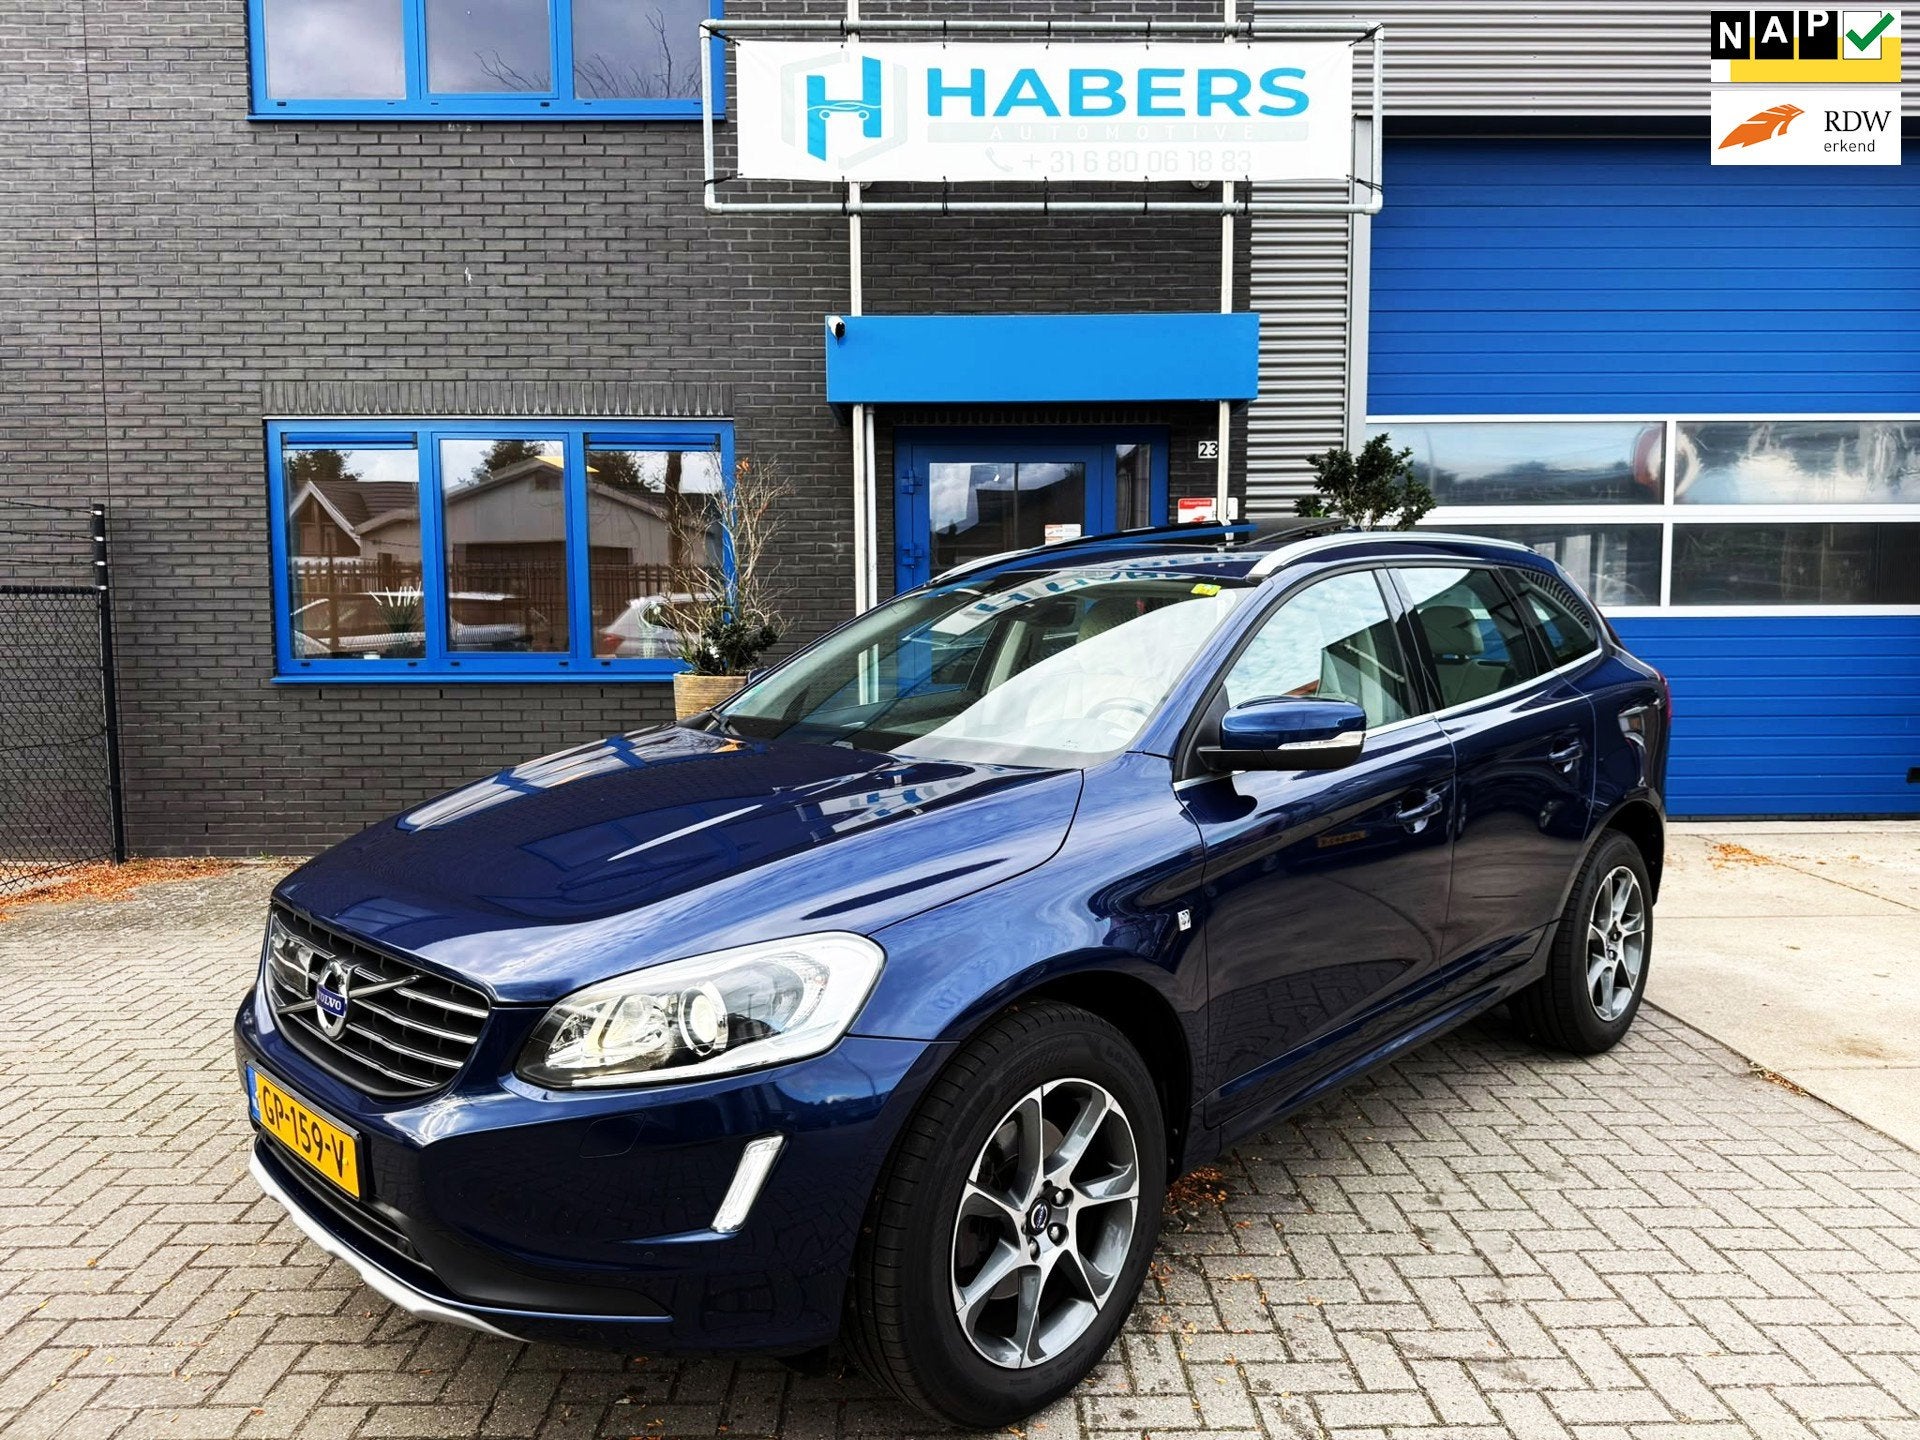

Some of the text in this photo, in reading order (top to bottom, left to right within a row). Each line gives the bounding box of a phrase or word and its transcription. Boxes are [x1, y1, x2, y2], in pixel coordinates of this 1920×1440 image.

[927, 67, 1309, 118] HABERS
[989, 124, 1254, 141] AUTOMOTIVE
[1050, 150, 1074, 173] 31
[1084, 150, 1098, 173] 6
[1107, 150, 1138, 173] 80
[1147, 150, 1178, 173] 06
[1187, 150, 1212, 173] 18
[1222, 150, 1252, 173] 83
[1199, 442, 1218, 457] 23
[262, 1085, 345, 1179] GP-159-V
